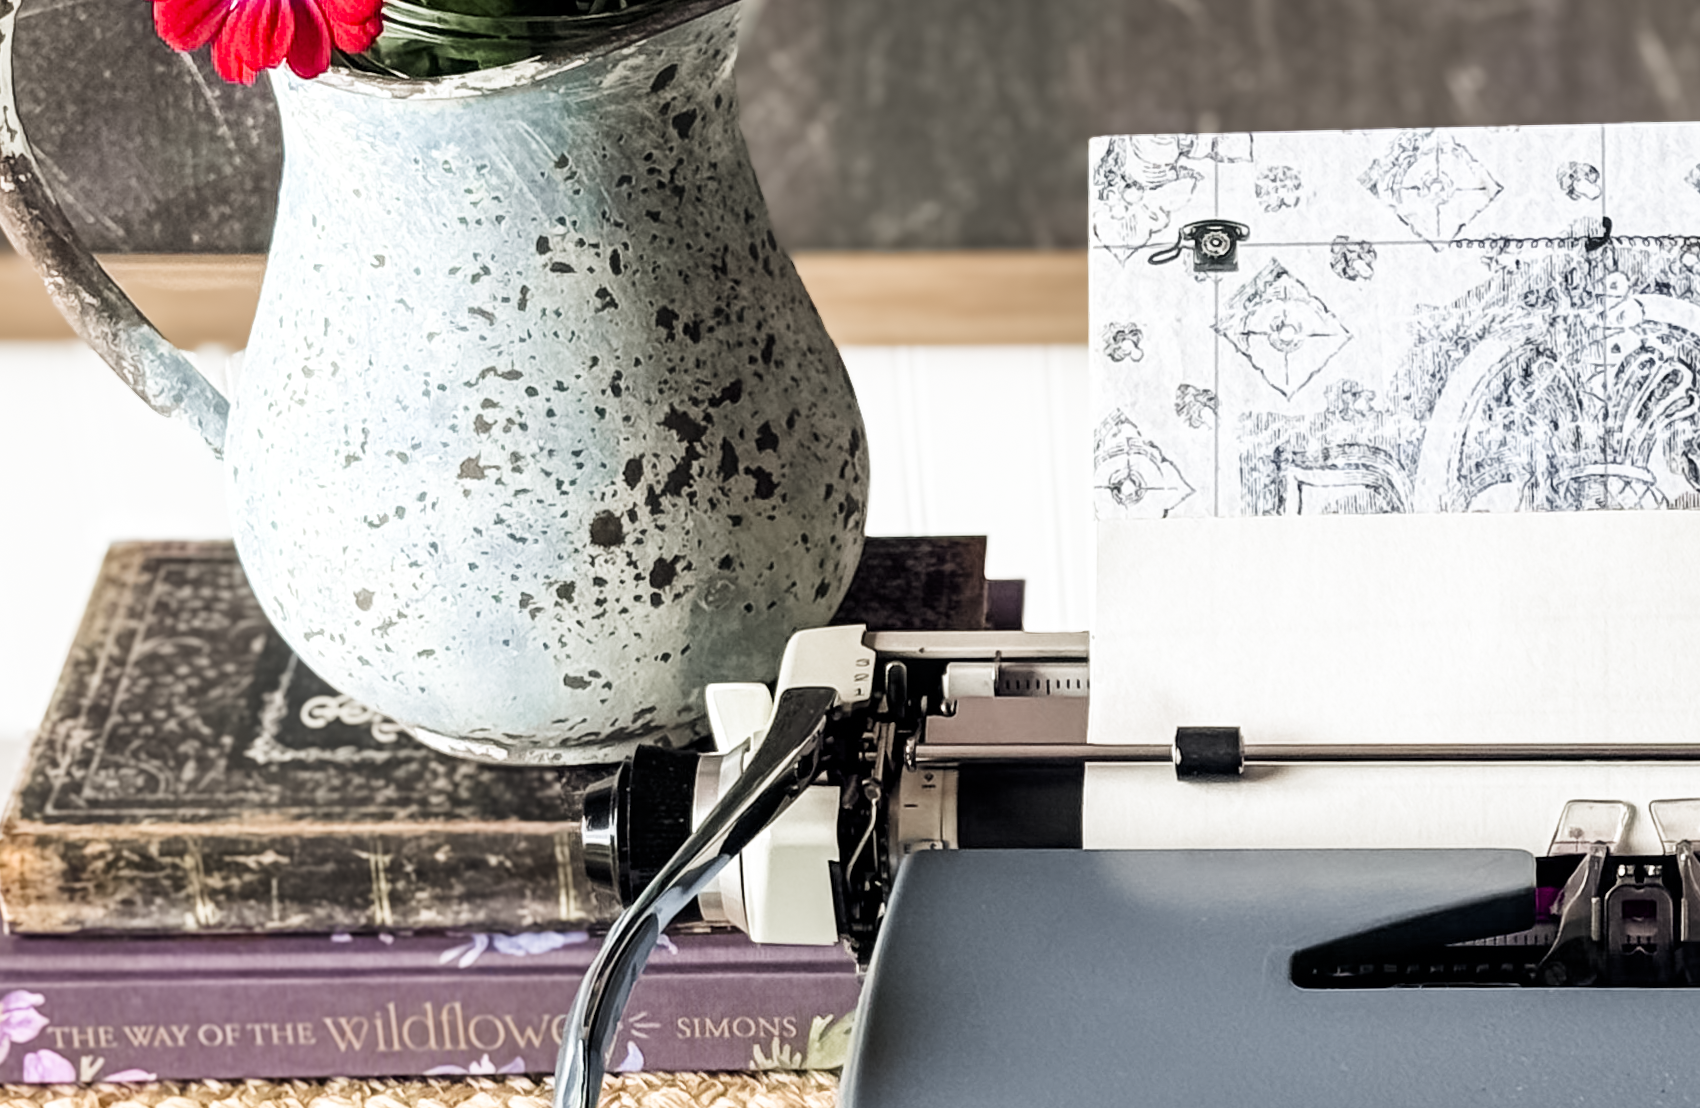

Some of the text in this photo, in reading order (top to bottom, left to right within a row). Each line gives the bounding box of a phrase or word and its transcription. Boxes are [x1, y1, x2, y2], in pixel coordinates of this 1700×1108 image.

[48, 1025, 117, 1050] THE
[123, 1023, 191, 1048] WAY
[197, 1023, 241, 1047] OF
[246, 1021, 317, 1046] THE
[676, 1016, 798, 1038] SIMONS
